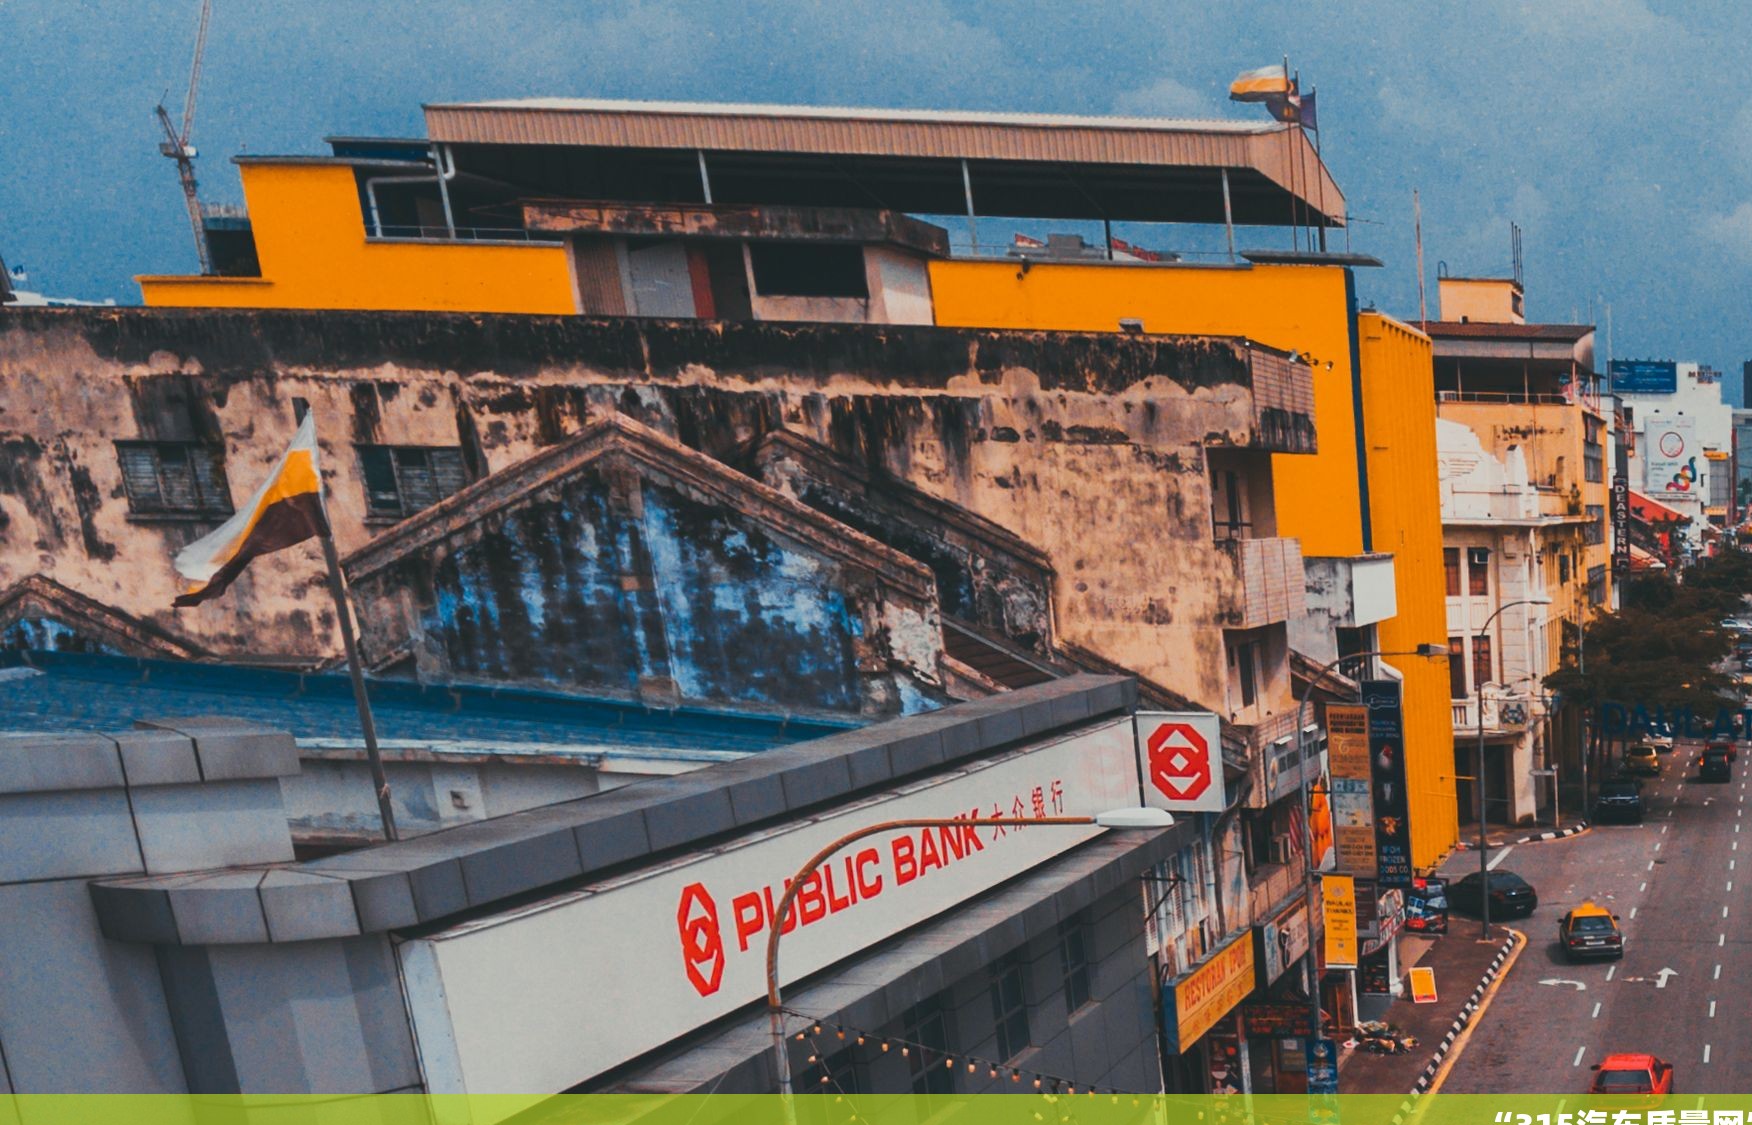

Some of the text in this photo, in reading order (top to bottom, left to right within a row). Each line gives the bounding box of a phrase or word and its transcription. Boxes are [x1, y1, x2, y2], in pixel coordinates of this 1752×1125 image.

[732, 807, 985, 952] PUBLIC BANK
[1184, 957, 1226, 1011] RESTORAN
